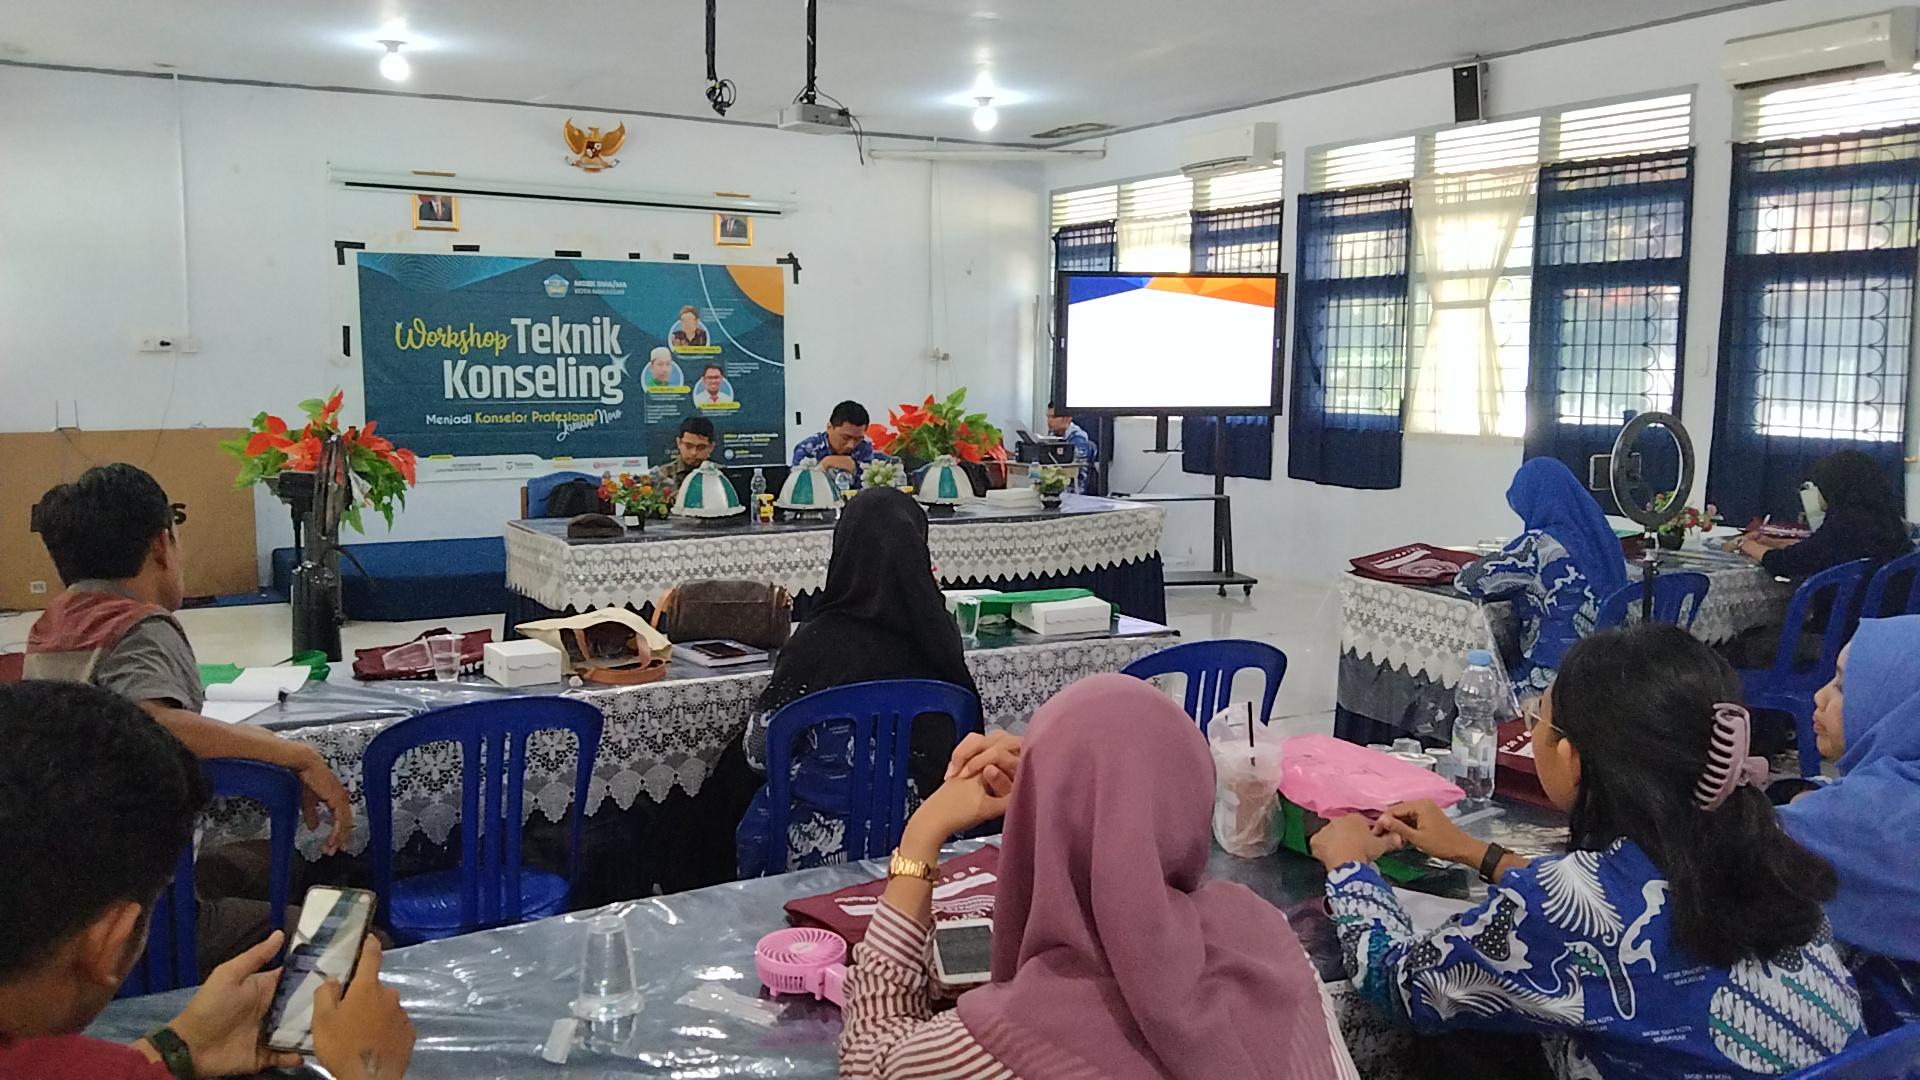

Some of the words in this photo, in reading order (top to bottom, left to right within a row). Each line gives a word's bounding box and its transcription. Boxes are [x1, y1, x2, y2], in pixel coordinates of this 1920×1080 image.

[395, 317, 512, 356] Workshop
[511, 316, 623, 355] Teknik
[444, 357, 624, 405] Konseling
[426, 414, 472, 425] Menjadi
[475, 412, 528, 424] Konselor
[532, 411, 598, 422] Profesional
